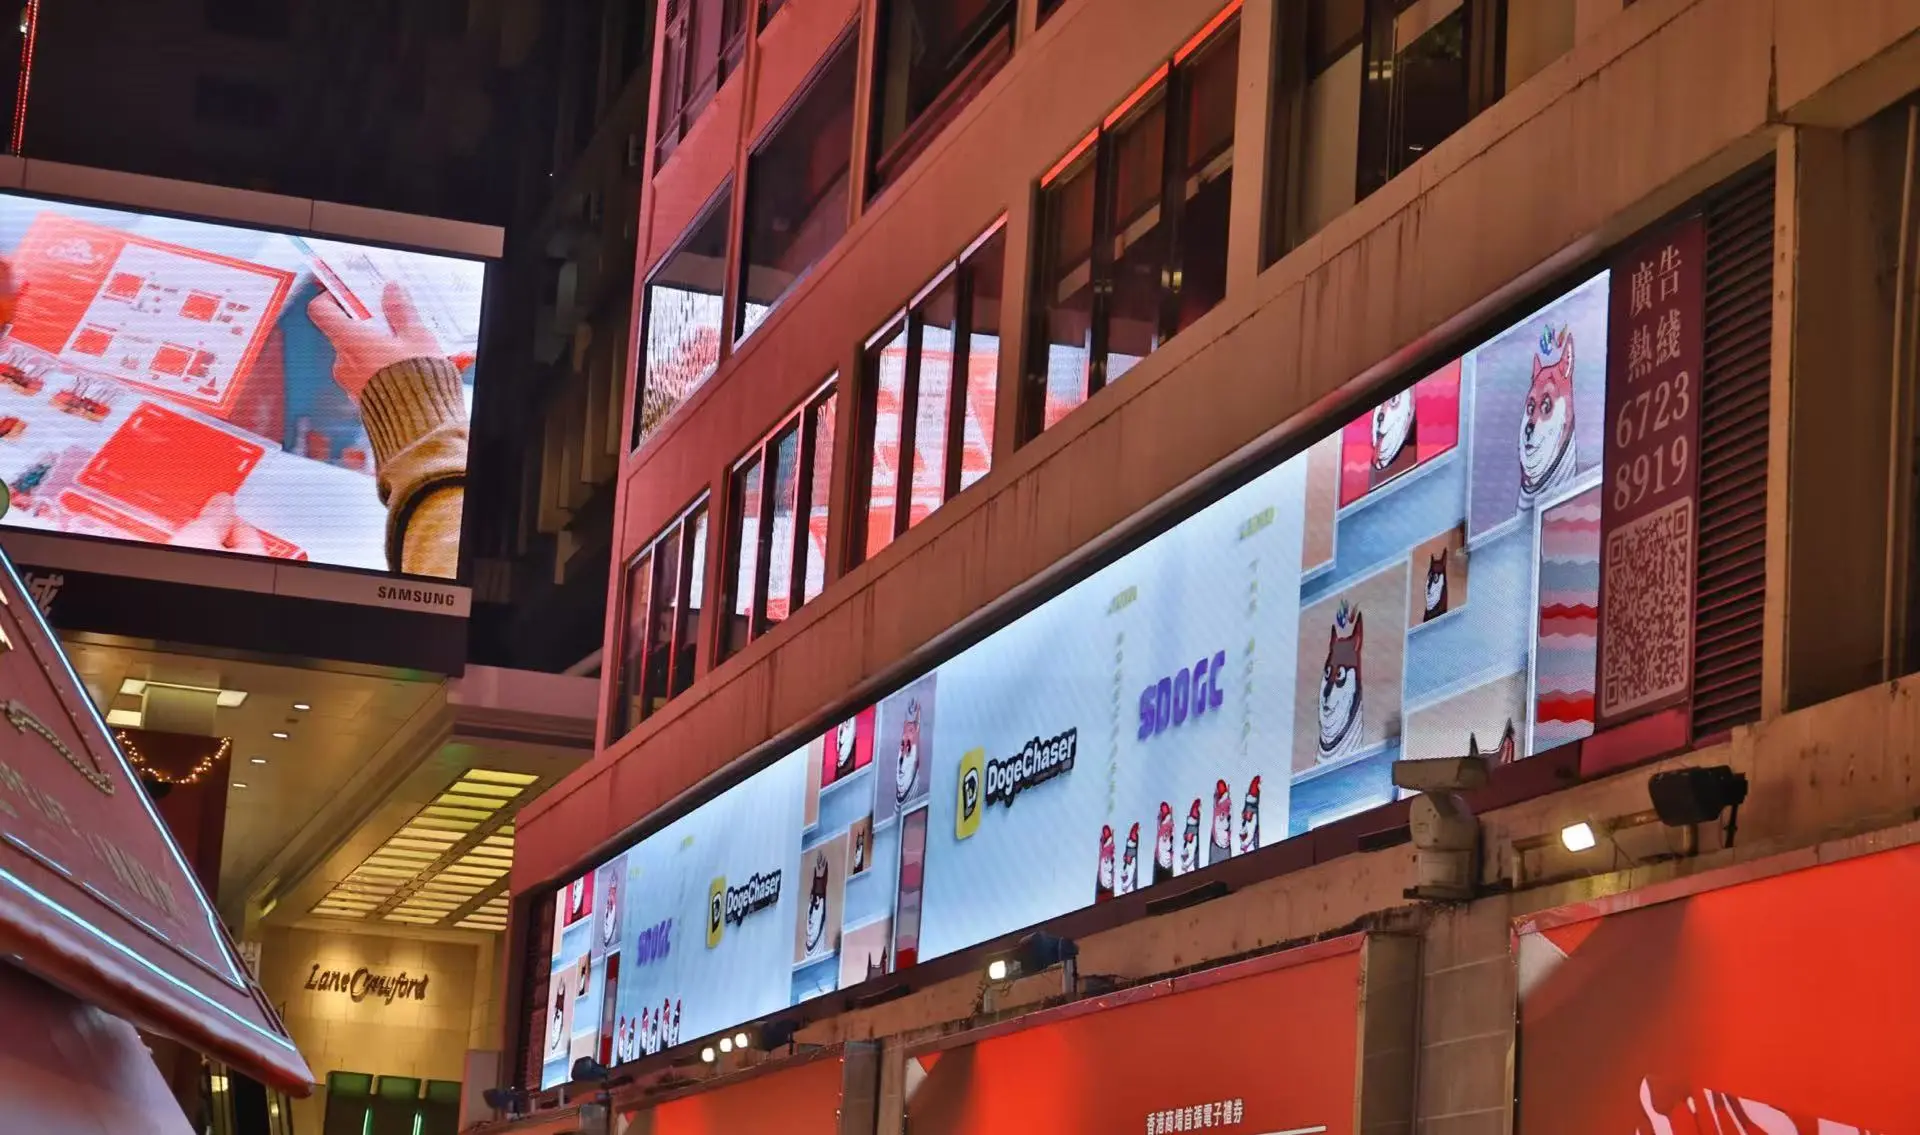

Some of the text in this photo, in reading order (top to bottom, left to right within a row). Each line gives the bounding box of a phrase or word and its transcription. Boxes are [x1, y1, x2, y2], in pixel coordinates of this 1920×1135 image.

[1629, 244, 1682, 318] 廣告
[1616, 371, 1689, 448] 6723
[1613, 435, 1688, 511] 8919
[378, 585, 455, 606] SAMSUNG
[986, 728, 1077, 802] DogeChaser
[726, 869, 781, 922] DogeChaser
[304, 963, 429, 1005] Lane Crawford
